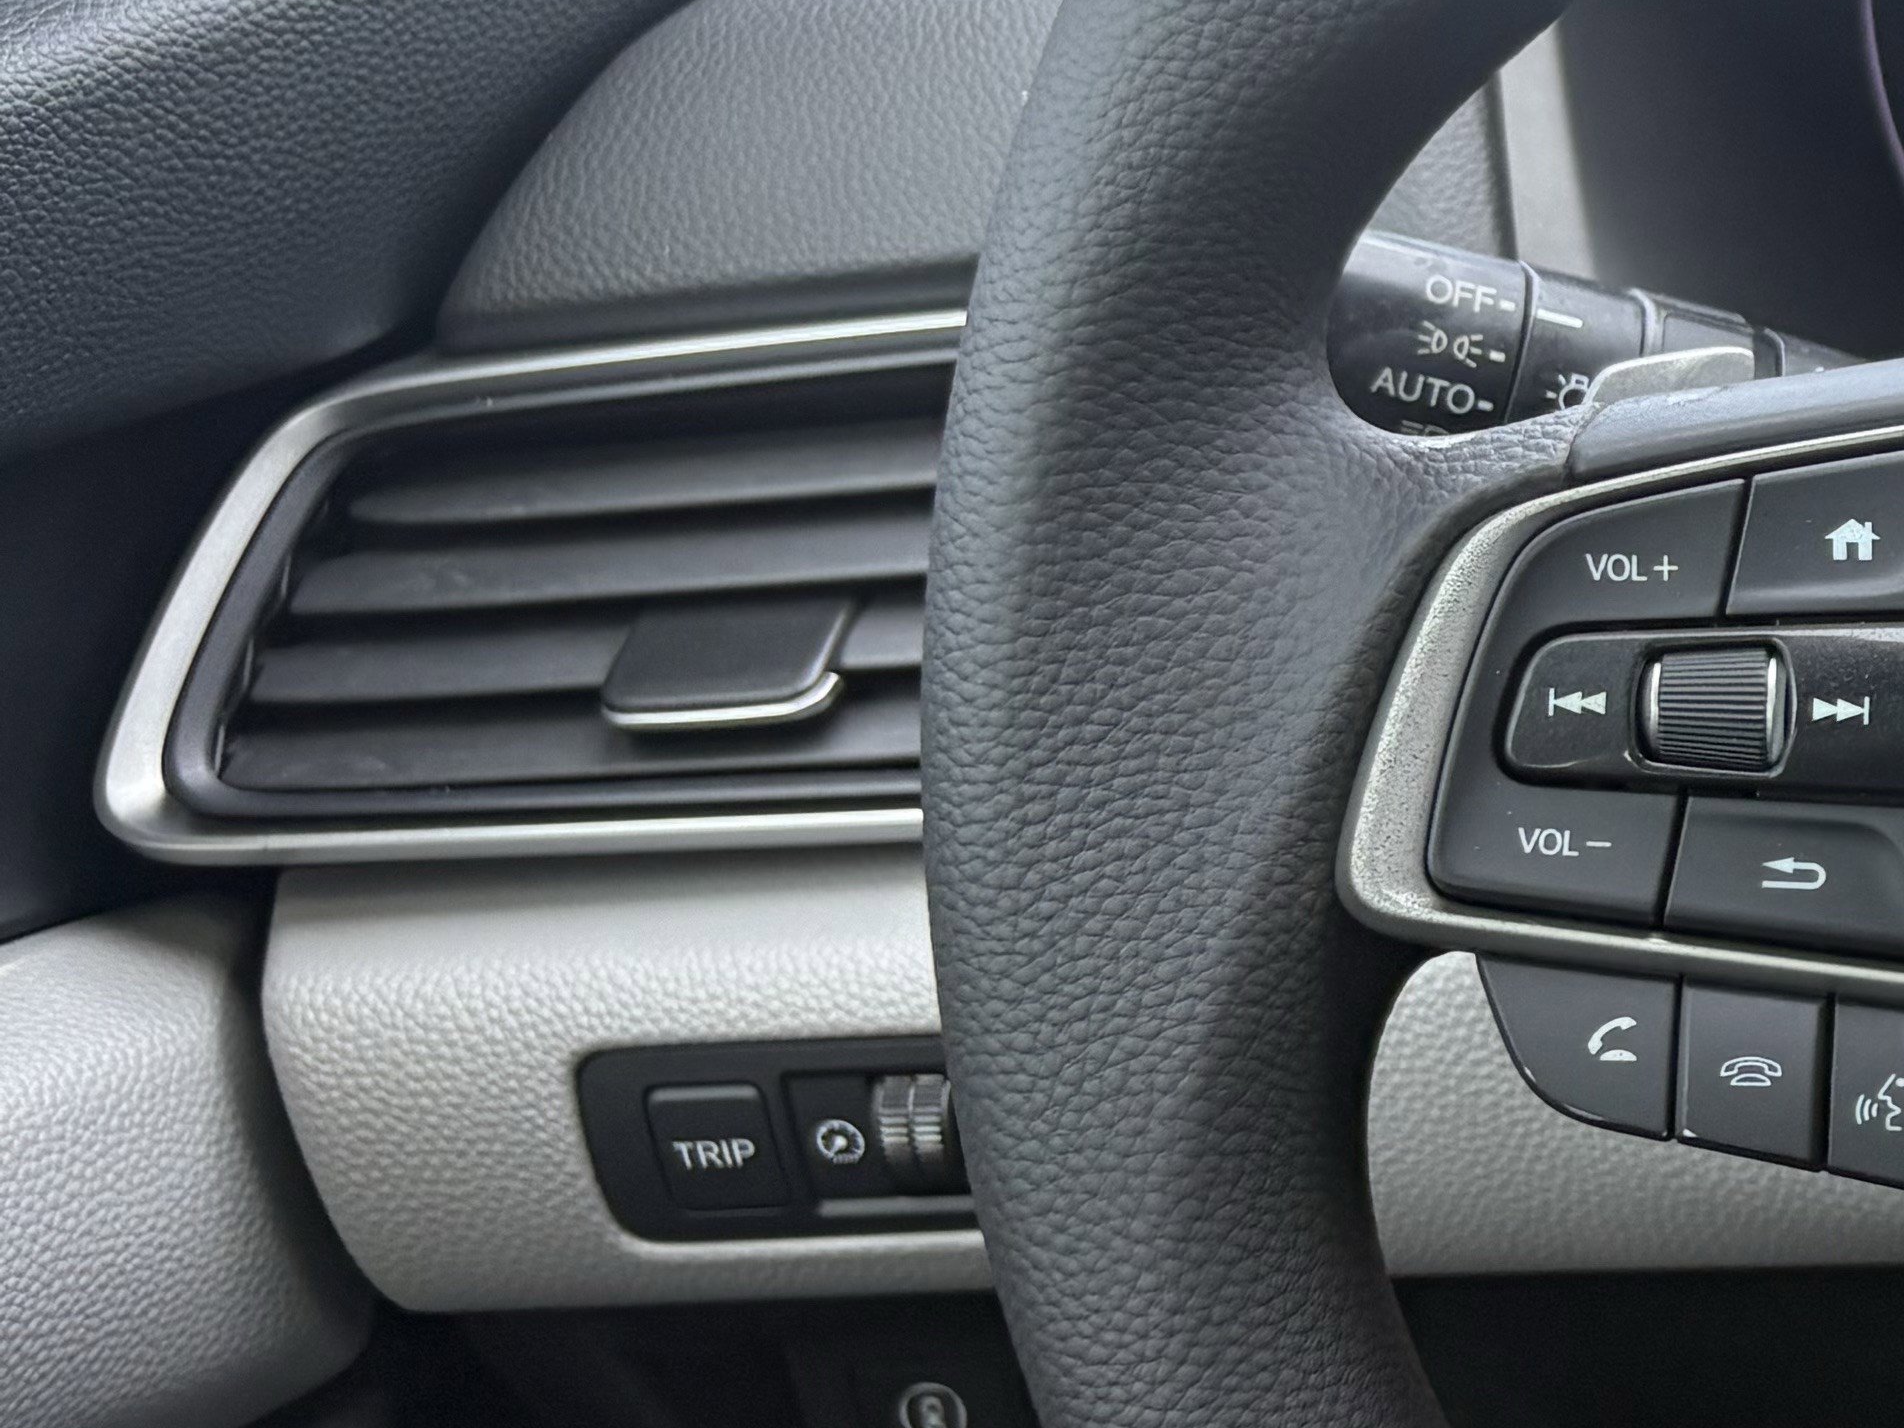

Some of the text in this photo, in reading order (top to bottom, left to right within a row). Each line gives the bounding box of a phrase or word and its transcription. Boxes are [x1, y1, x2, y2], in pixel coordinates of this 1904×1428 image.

[1425, 274, 1498, 313] OFF
[1369, 366, 1476, 415] AUTO
[671, 1137, 756, 1172] TRIP
